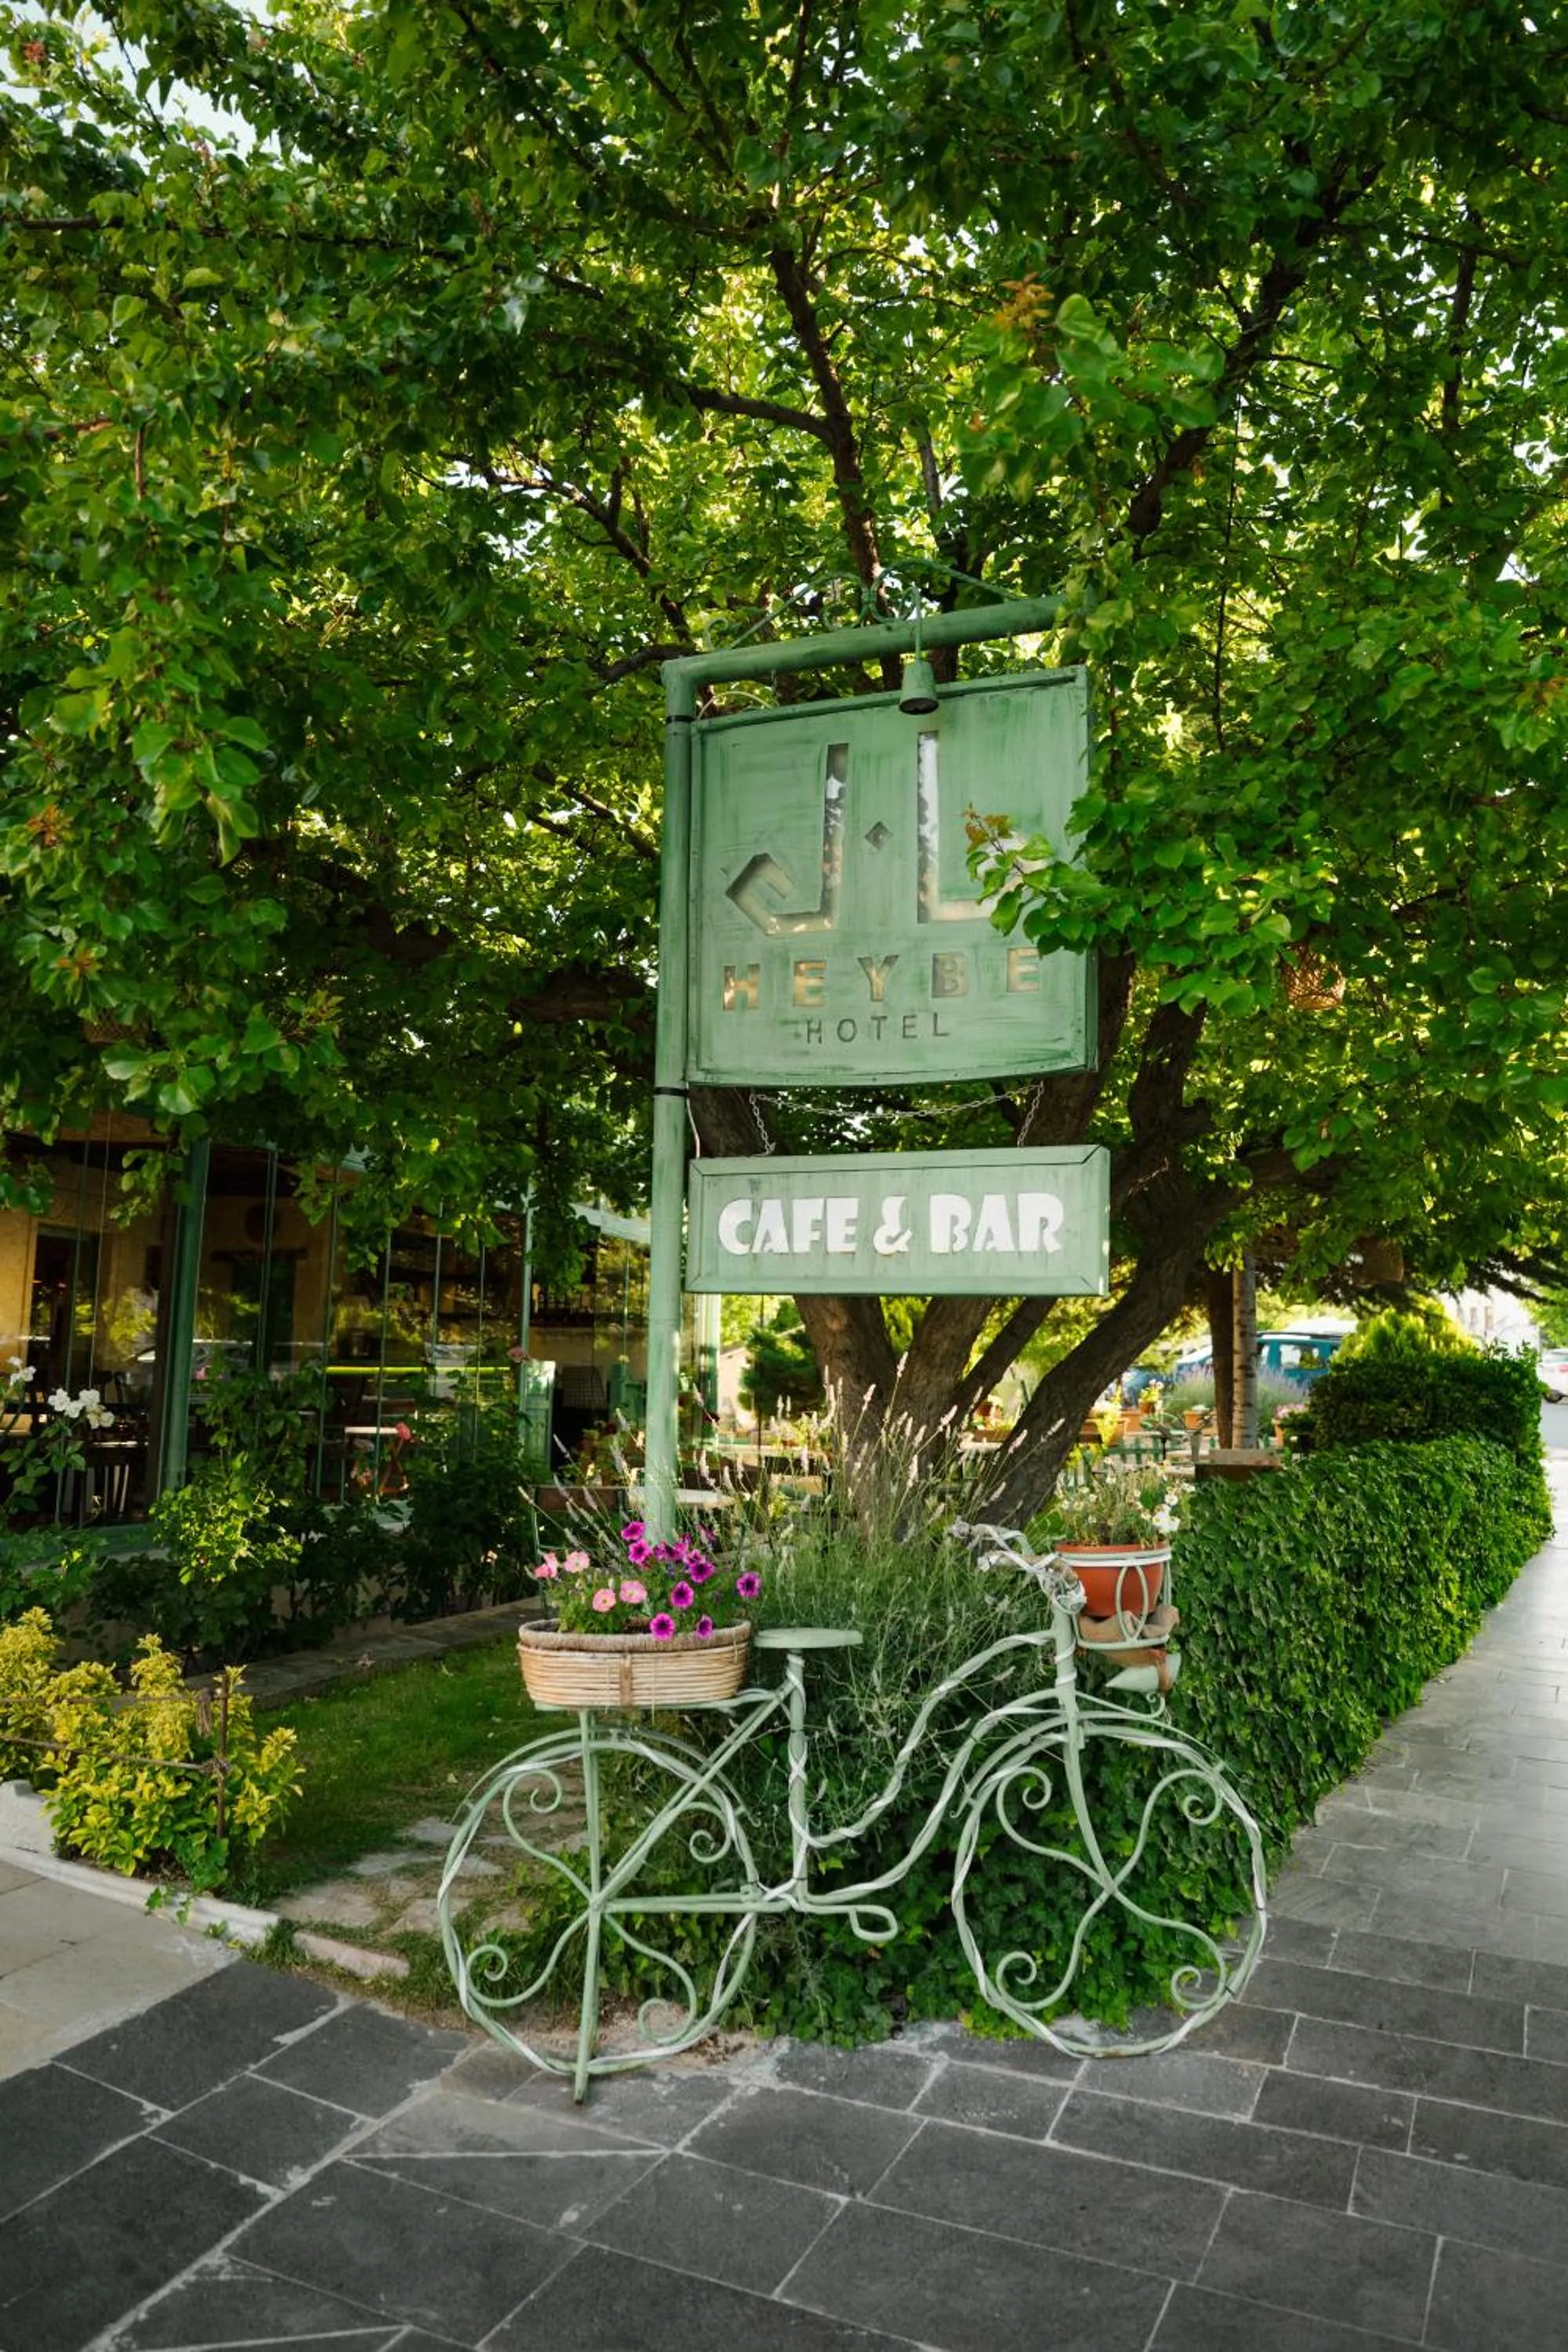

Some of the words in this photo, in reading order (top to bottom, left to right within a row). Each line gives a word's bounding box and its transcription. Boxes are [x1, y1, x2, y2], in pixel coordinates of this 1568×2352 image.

[723, 947, 1040, 1011] HEYBE
[805, 1011, 950, 1044] HOTEL
[718, 1196, 859, 1255] CAFE
[873, 1195, 912, 1256] &
[929, 1192, 1065, 1254] BAR
